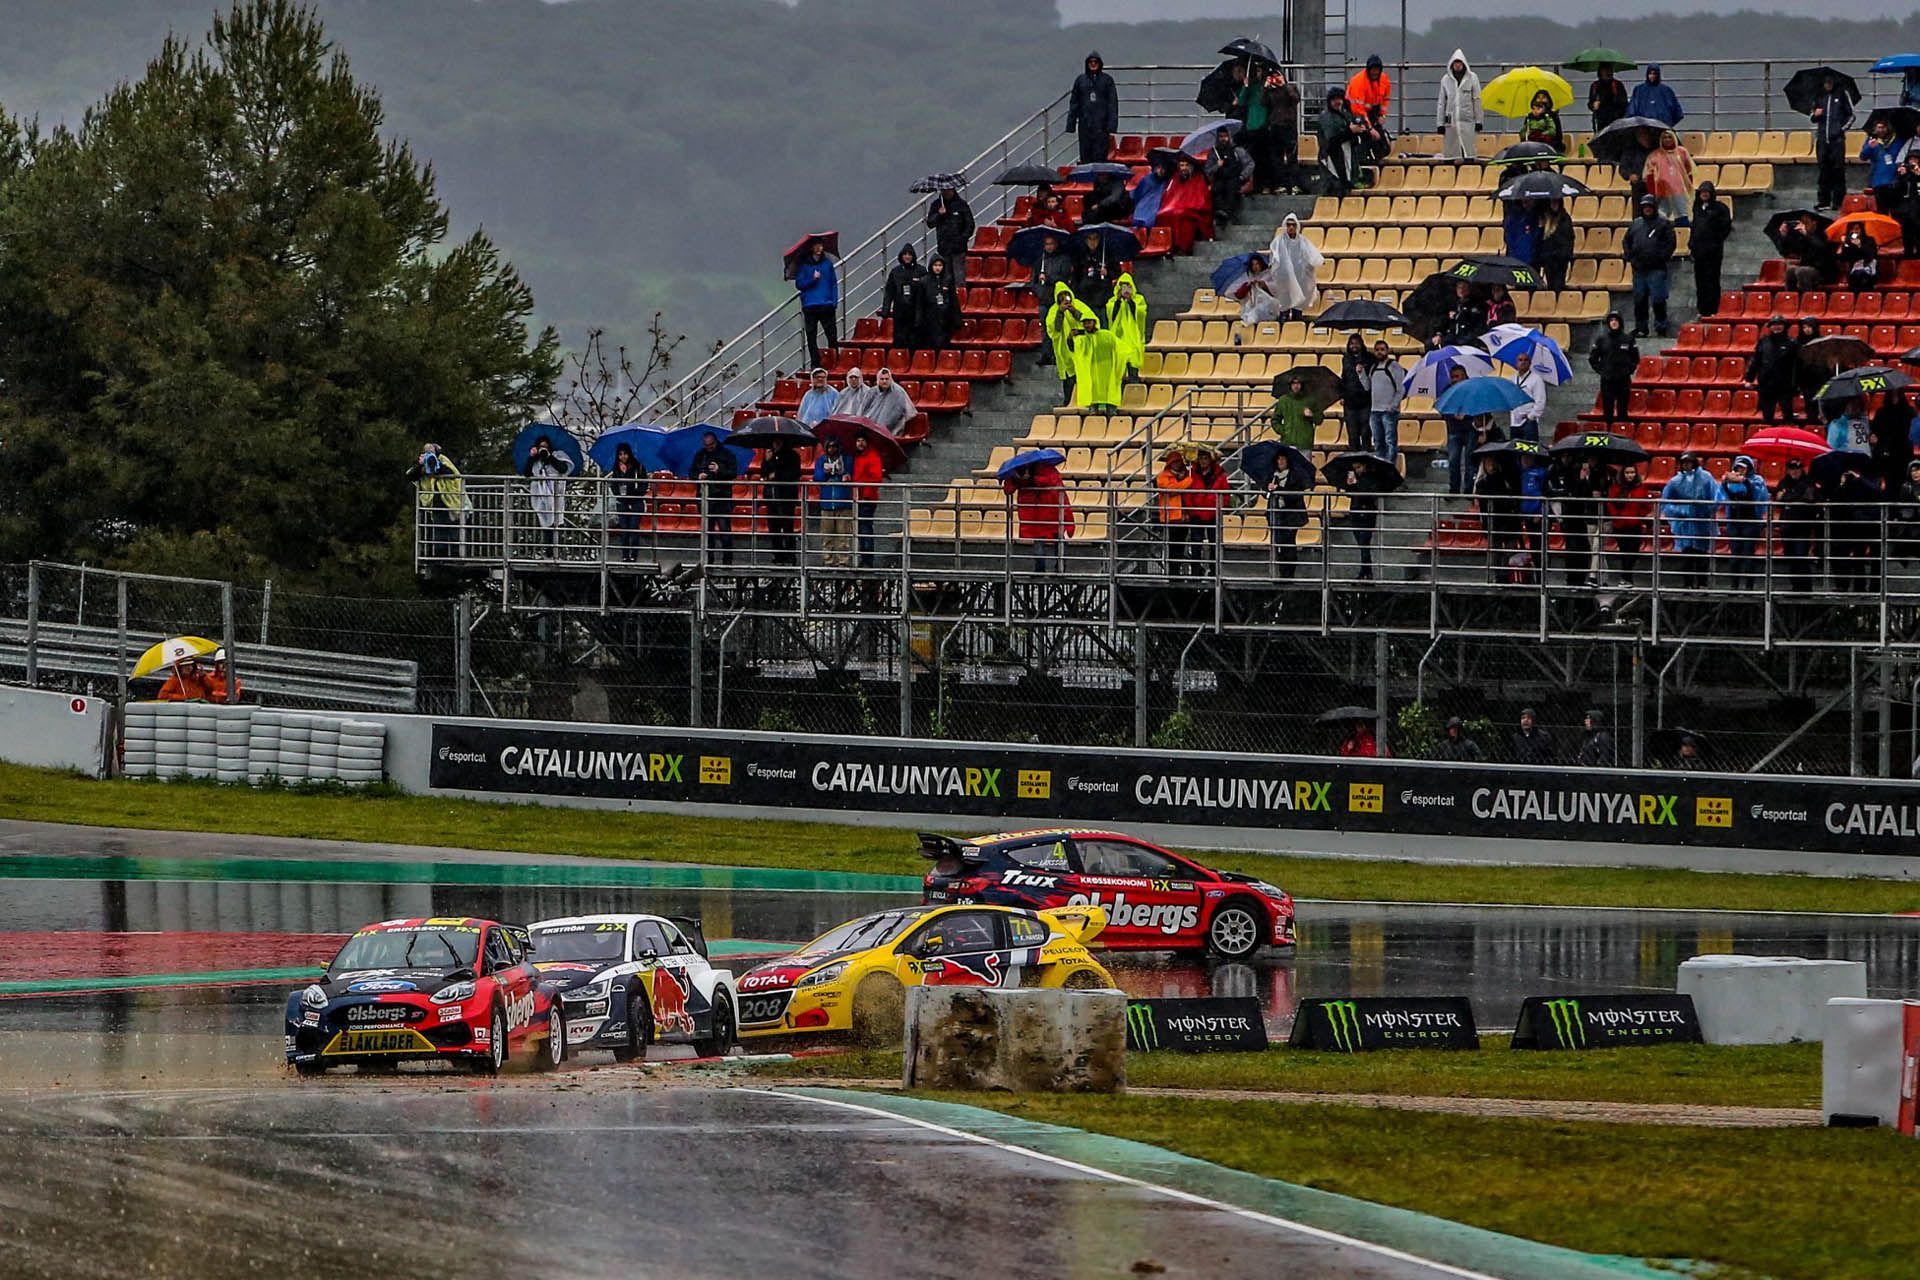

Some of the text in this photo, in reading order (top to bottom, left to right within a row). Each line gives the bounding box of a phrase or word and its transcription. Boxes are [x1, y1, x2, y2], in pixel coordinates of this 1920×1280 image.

[449, 751, 486, 764] esportcat
[757, 766, 797, 780] esportcat
[1078, 780, 1119, 794] esportcat
[1412, 793, 1455, 808] esportcat
[1762, 808, 1808, 822] esportcat
[1825, 802, 1920, 837] CATAL
[1053, 842, 1065, 859] 4
[1009, 918, 1032, 935] 71
[1042, 947, 1087, 956] PEUGEOT
[1060, 957, 1090, 966] TOTAL
[743, 974, 790, 989] TOTAL
[741, 998, 782, 1020] 208
[1167, 1015, 1251, 1032] MONSTER
[1365, 1010, 1462, 1031] MONSTER
[1587, 1008, 1685, 1026] MONSTER
[1383, 1031, 1450, 1039] ENERGY
[1607, 1028, 1674, 1036] ENERGY
